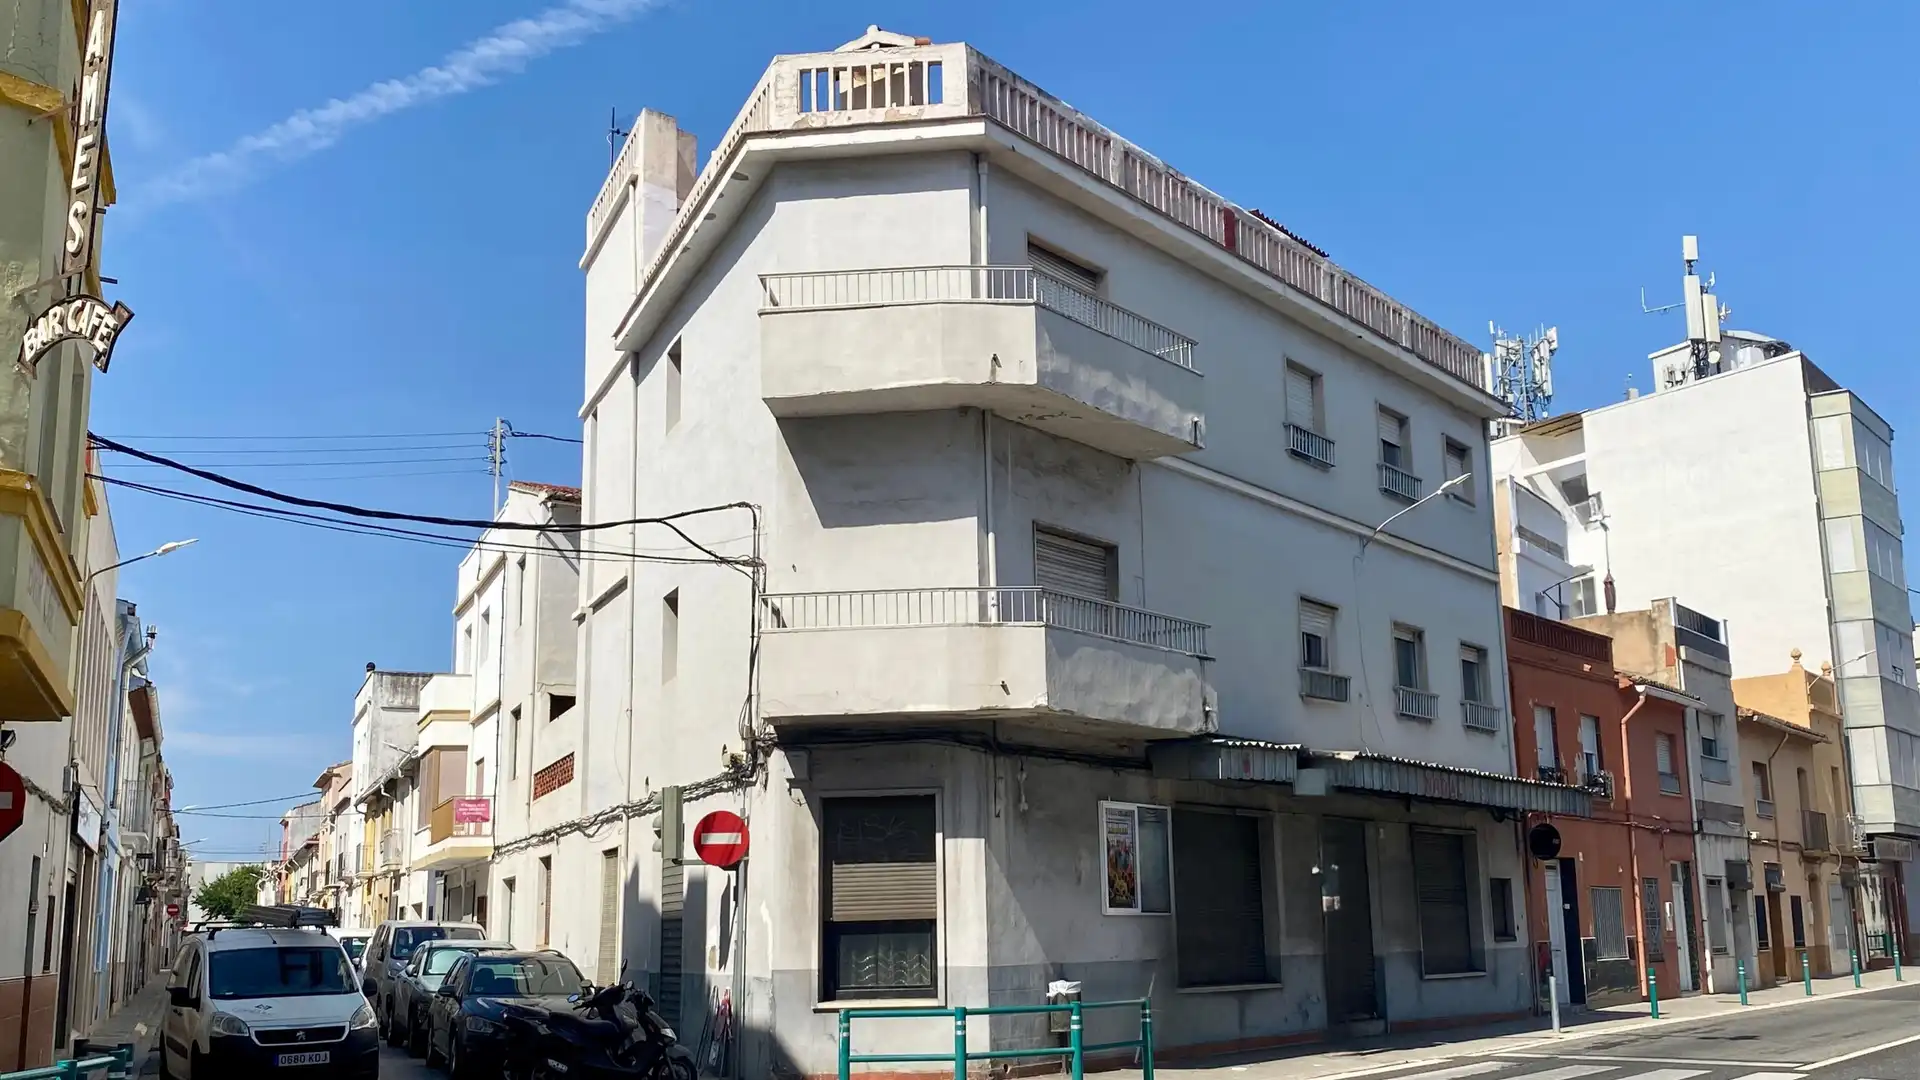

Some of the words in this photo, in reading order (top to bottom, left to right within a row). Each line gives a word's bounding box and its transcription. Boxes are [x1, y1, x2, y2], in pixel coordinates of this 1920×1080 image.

[23, 305, 64, 362] BAR
[67, 299, 118, 353] CAFE
[280, 1054, 306, 1065] 0680
[308, 1052, 328, 1063] KDJ
